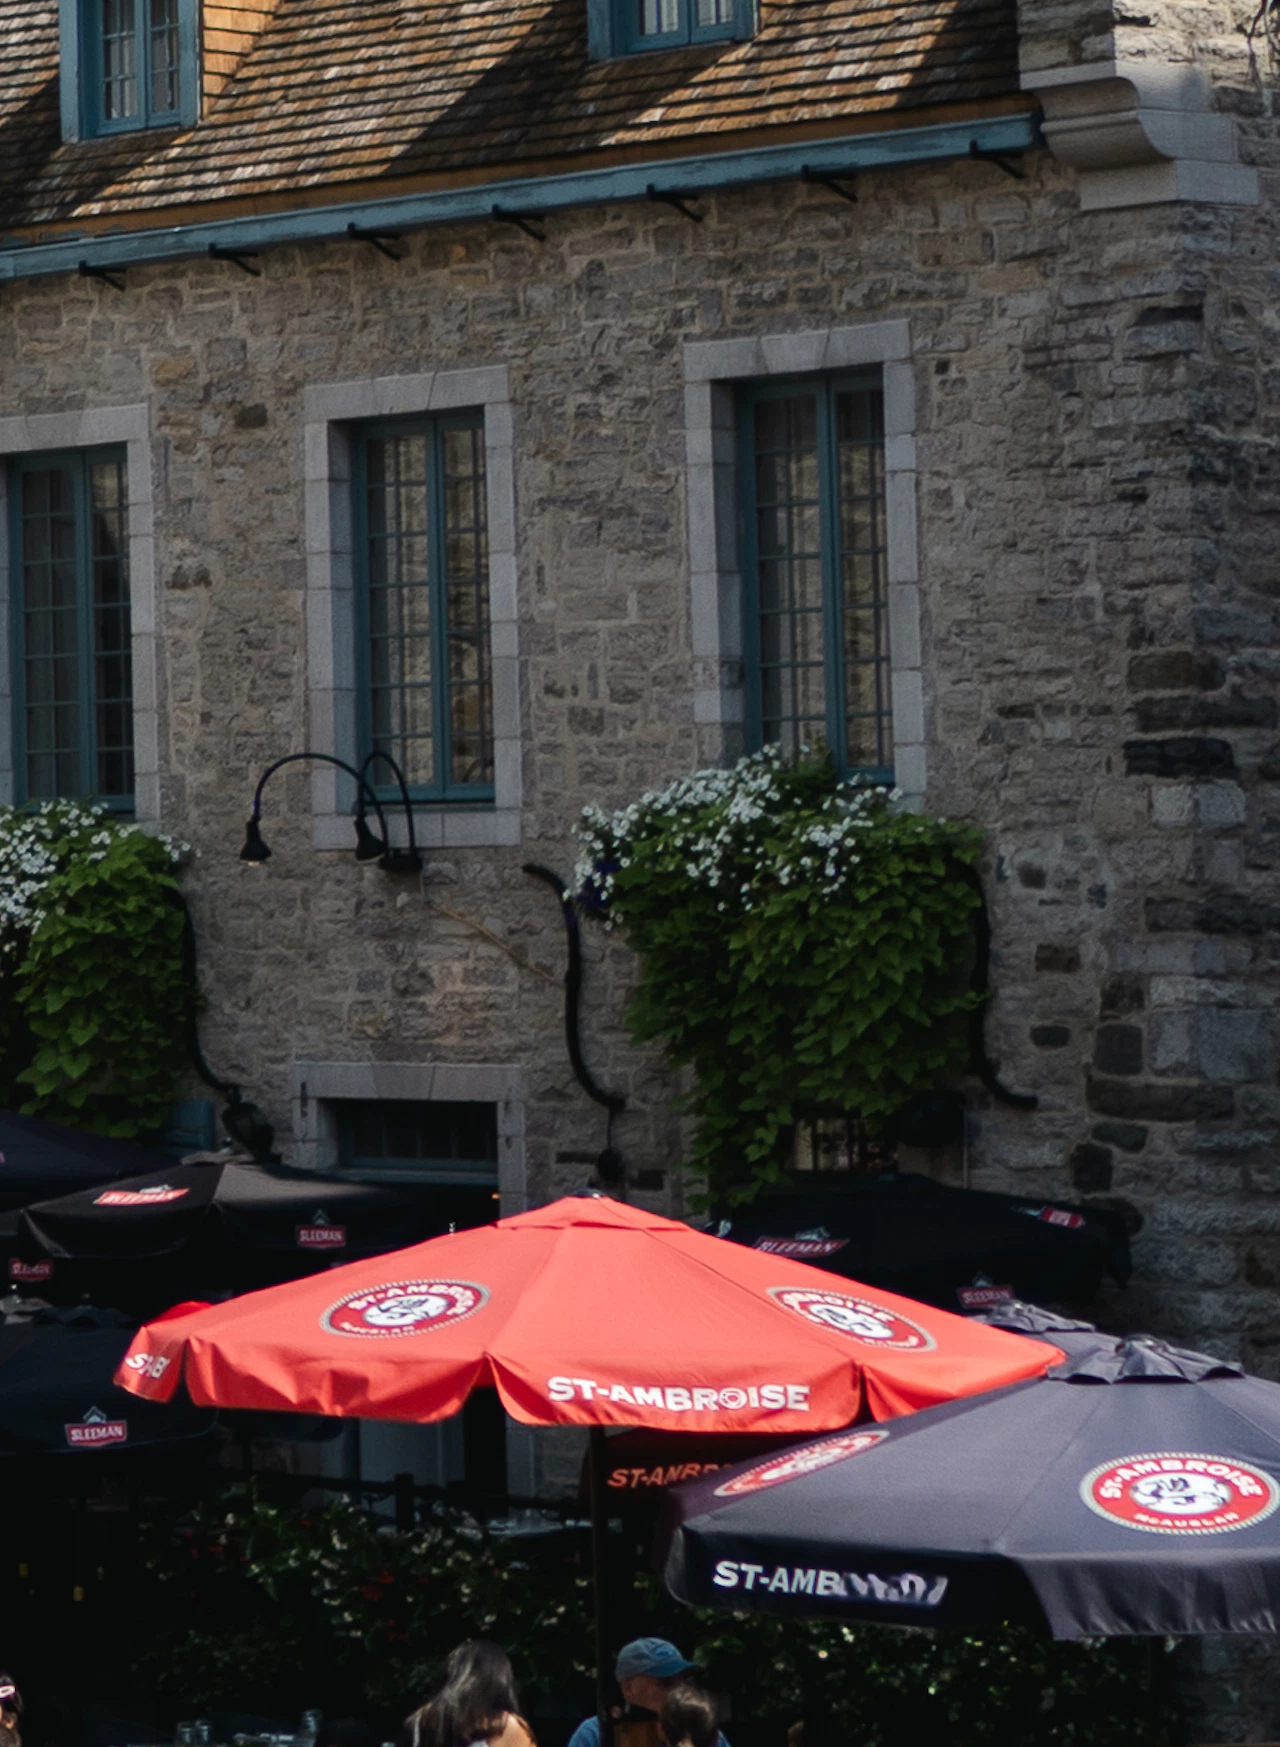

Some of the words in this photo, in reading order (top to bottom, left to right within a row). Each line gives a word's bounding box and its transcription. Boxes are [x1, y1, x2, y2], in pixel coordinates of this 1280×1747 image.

[547, 1375, 811, 1413] ST-AMBROISE
[70, 1426, 124, 1442] SLEEMAN
[1099, 1459, 1264, 1499] ST-AMBROISE
